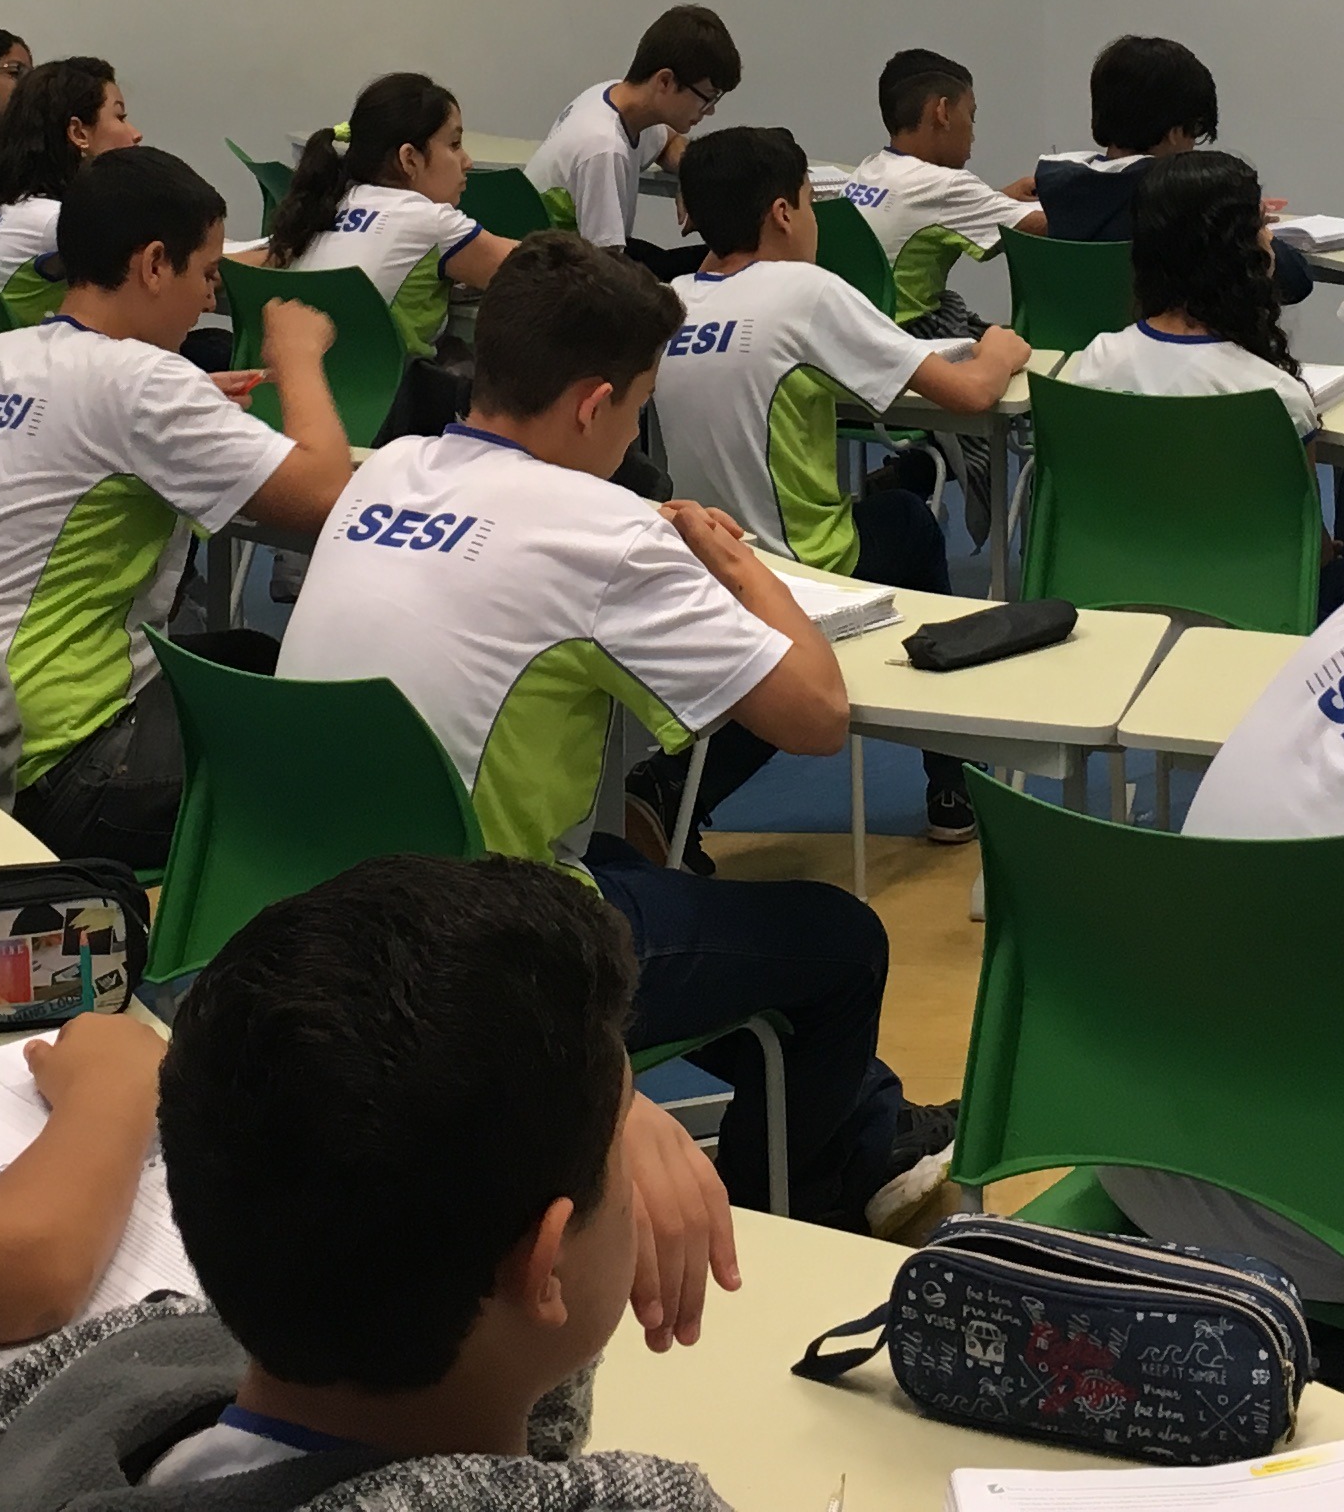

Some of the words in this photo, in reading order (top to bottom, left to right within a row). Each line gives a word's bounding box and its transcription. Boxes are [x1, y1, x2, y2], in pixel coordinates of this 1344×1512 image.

[333, 208, 380, 233] ESI
[666, 320, 738, 357] ESI
[346, 503, 479, 553] SESI
[49, 995, 82, 1011] LOOS
[1141, 1362, 1169, 1378] KEEP
[1172, 1366, 1184, 1380] IT
[1188, 1367, 1227, 1386] SIMPLE
